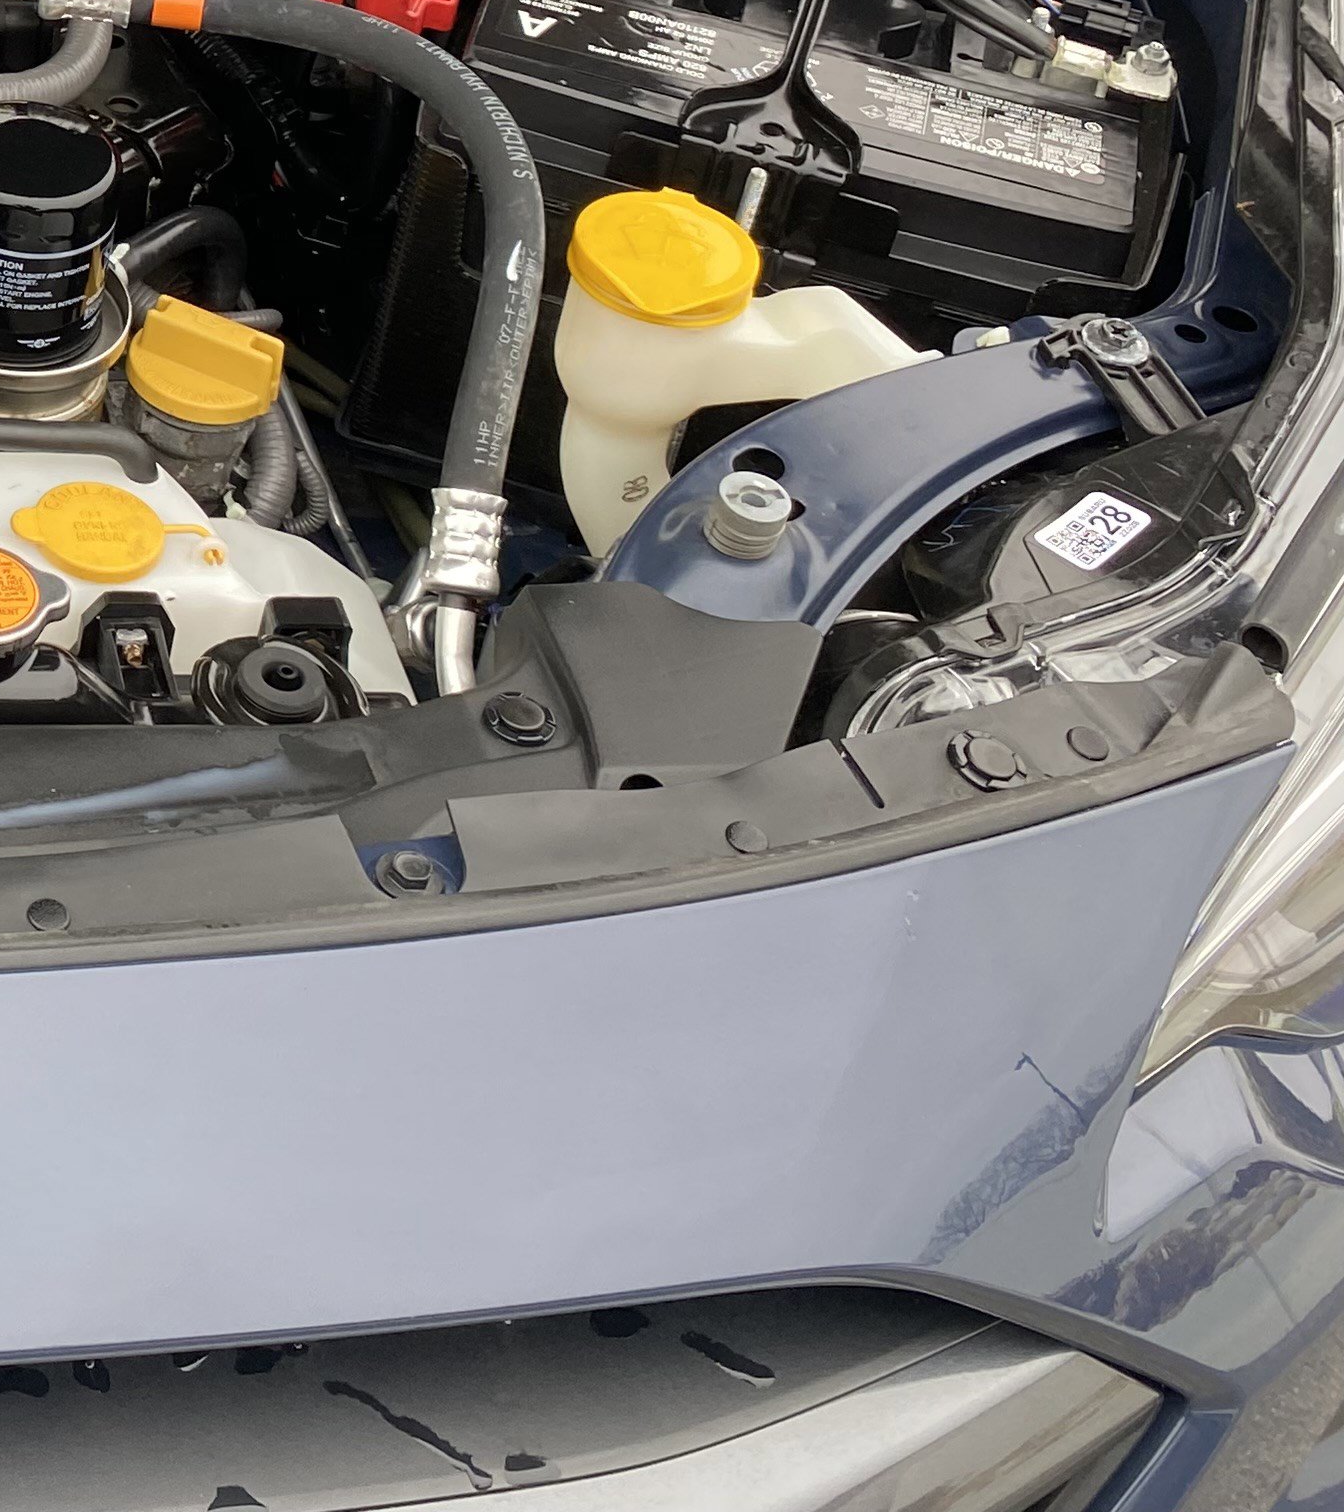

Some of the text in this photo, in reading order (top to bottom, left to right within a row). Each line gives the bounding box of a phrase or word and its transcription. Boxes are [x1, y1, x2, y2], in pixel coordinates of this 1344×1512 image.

[587, 44, 706, 79] COLD CRANKING AMPS
[637, 48, 680, 65] AMPS
[684, 42, 712, 55] LN2
[938, 135, 1066, 174] DANGER/POISON
[473, 419, 491, 465] 11HP
[1088, 505, 1132, 535] 28
